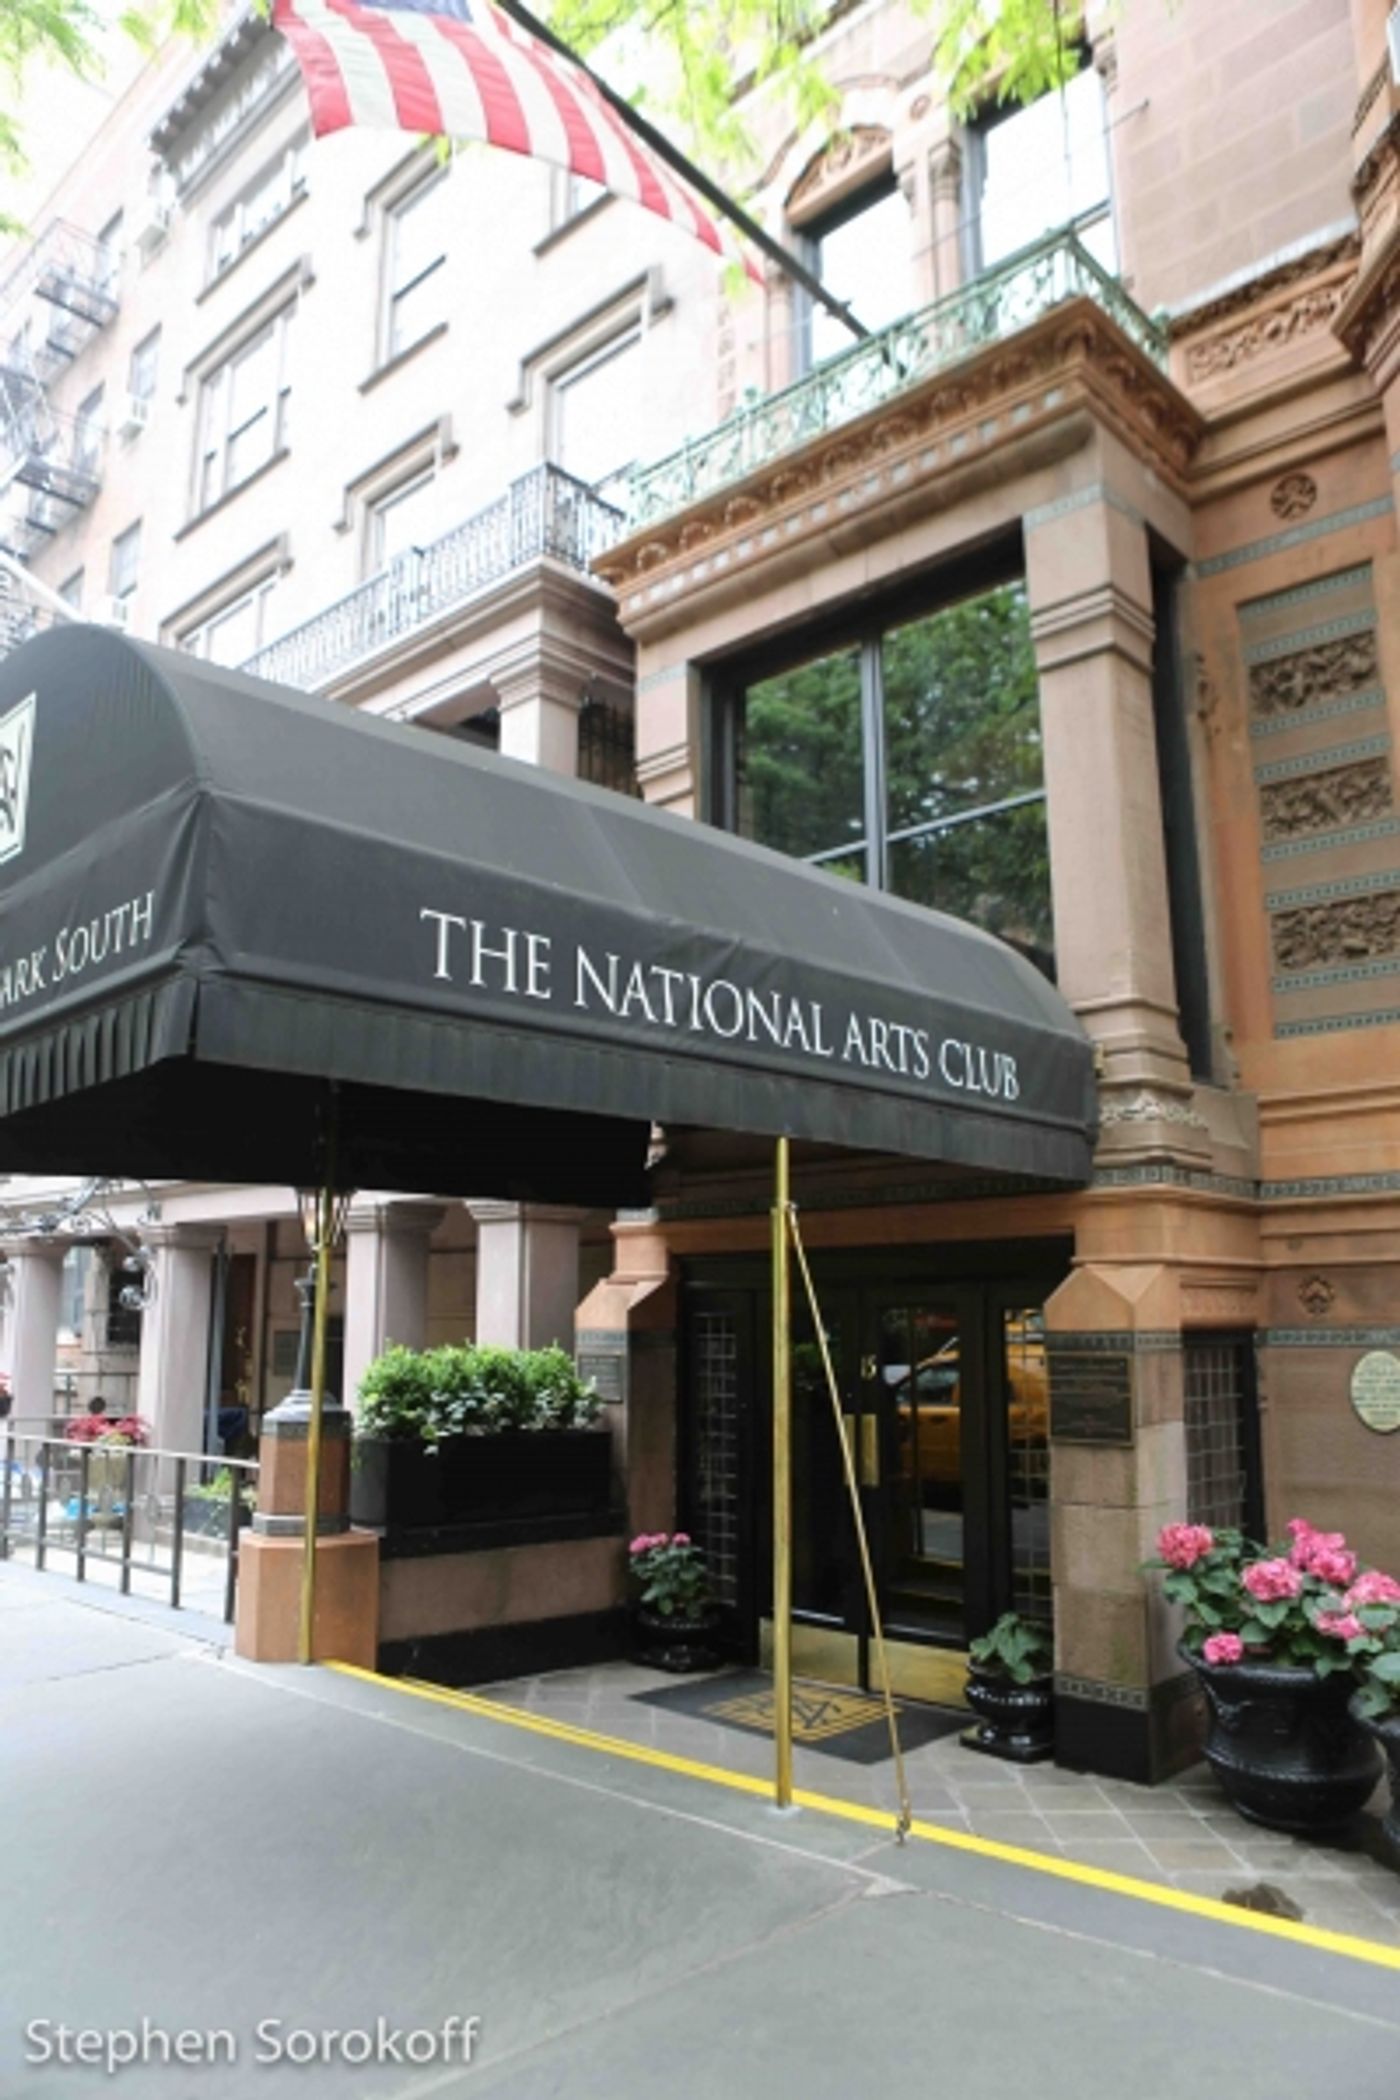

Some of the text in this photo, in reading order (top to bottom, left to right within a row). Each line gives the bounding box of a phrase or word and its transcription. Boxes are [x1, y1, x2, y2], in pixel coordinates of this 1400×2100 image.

[53, 890, 154, 982] SOUTH
[419, 908, 1020, 1101] THE NATIONAL ARTS CLUB
